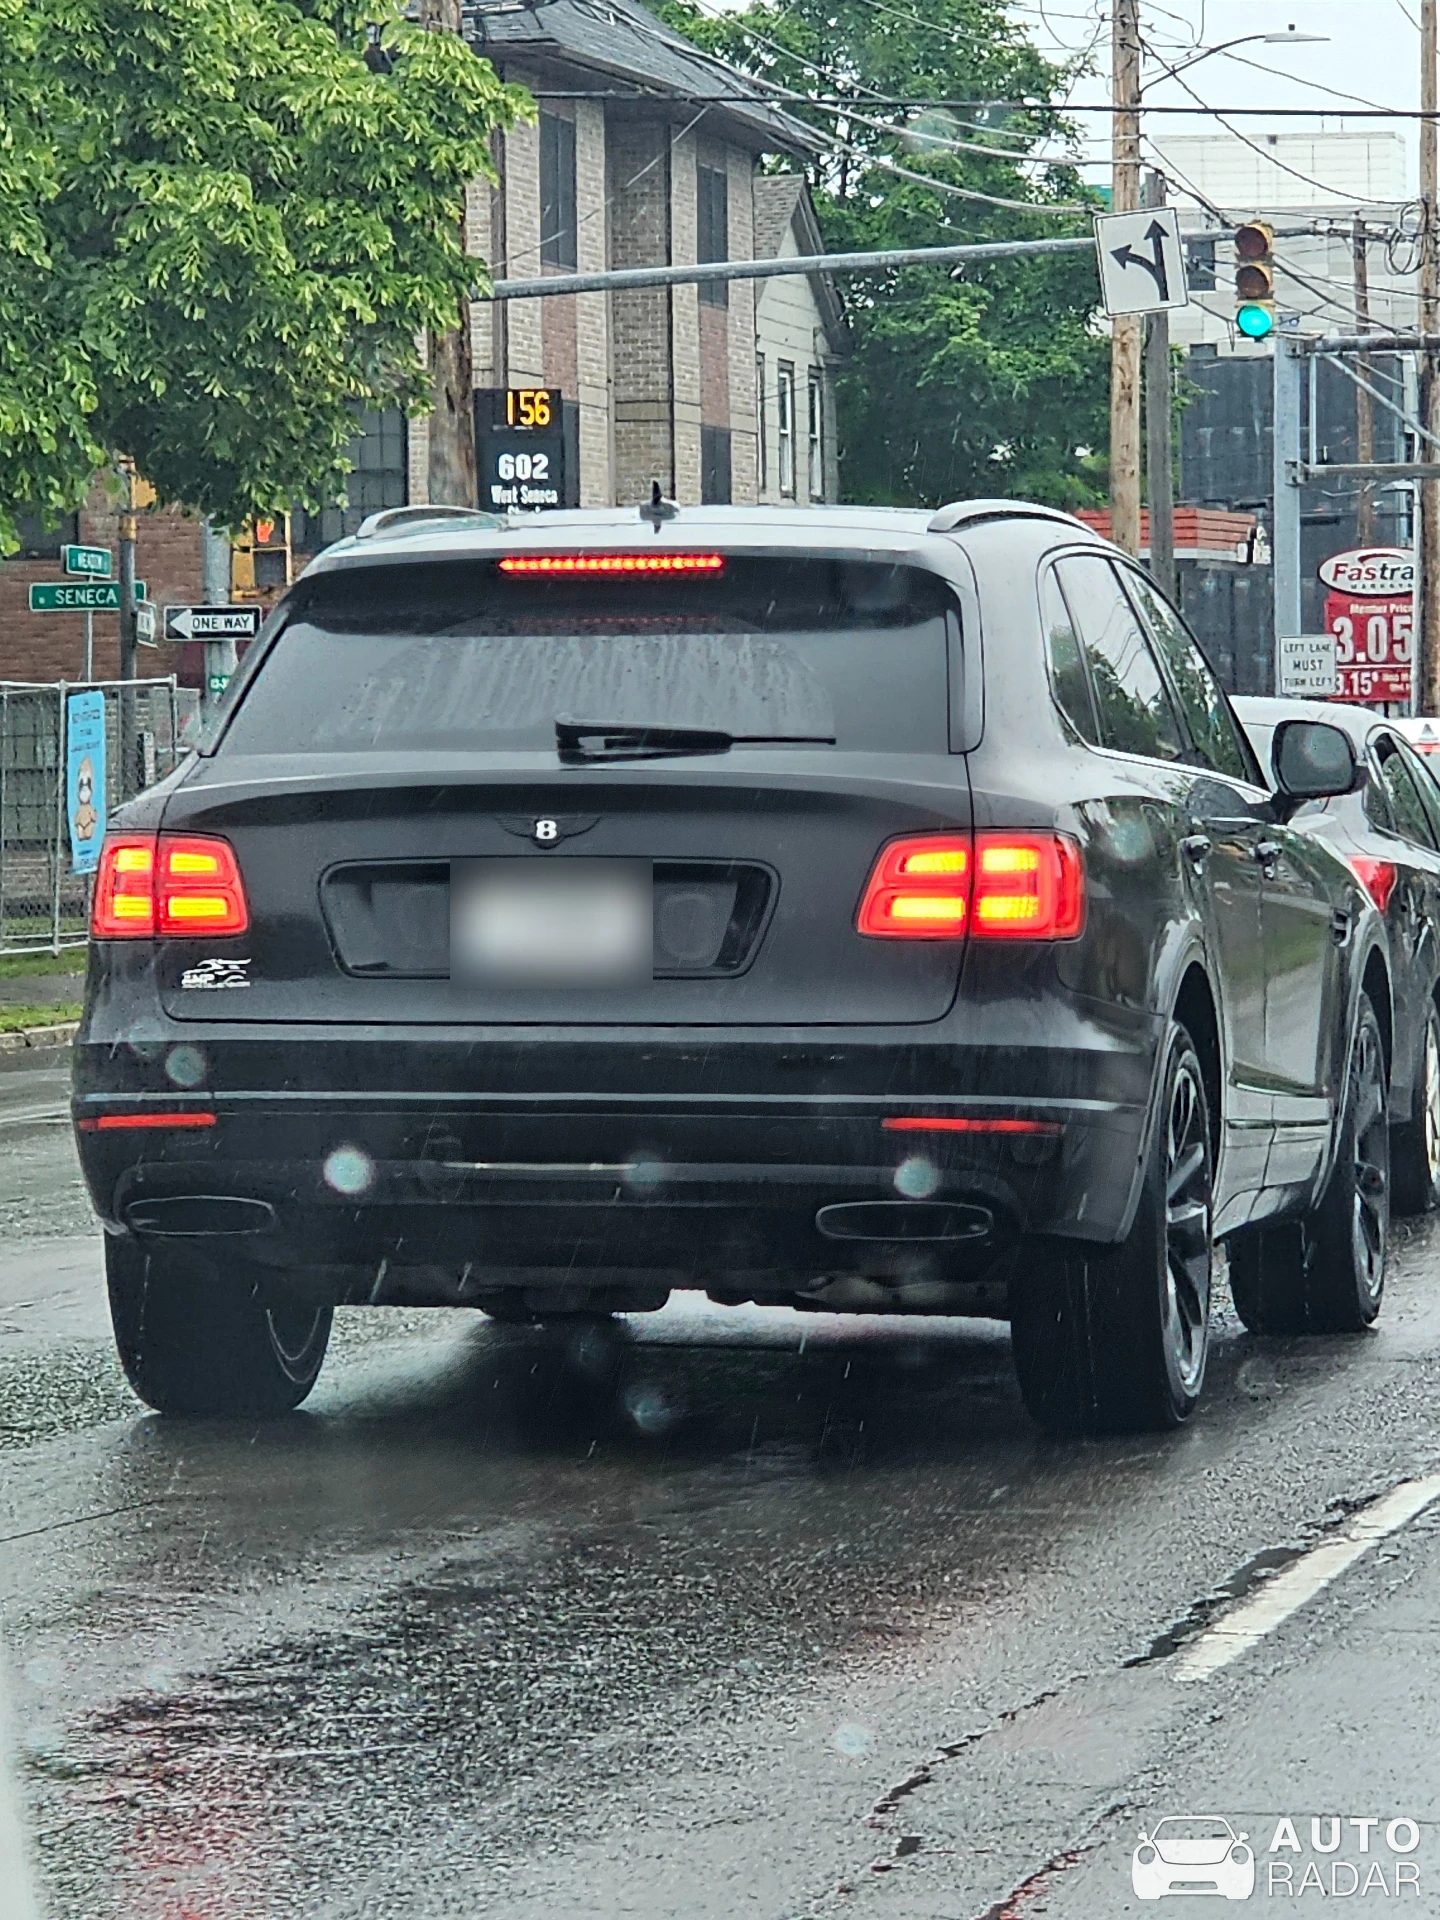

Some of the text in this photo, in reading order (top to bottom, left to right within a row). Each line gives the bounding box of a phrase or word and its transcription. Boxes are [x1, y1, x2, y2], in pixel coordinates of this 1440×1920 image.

[498, 453, 549, 480] 602
[1332, 562, 1413, 582] Fastra
[55, 588, 118, 605] SENECA
[192, 616, 249, 630] ONE WAY
[1284, 643, 1331, 653] LEFT LANE
[1293, 659, 1323, 671] MUST
[1310, 677, 1332, 687] LEFT
[536, 820, 557, 840] B
